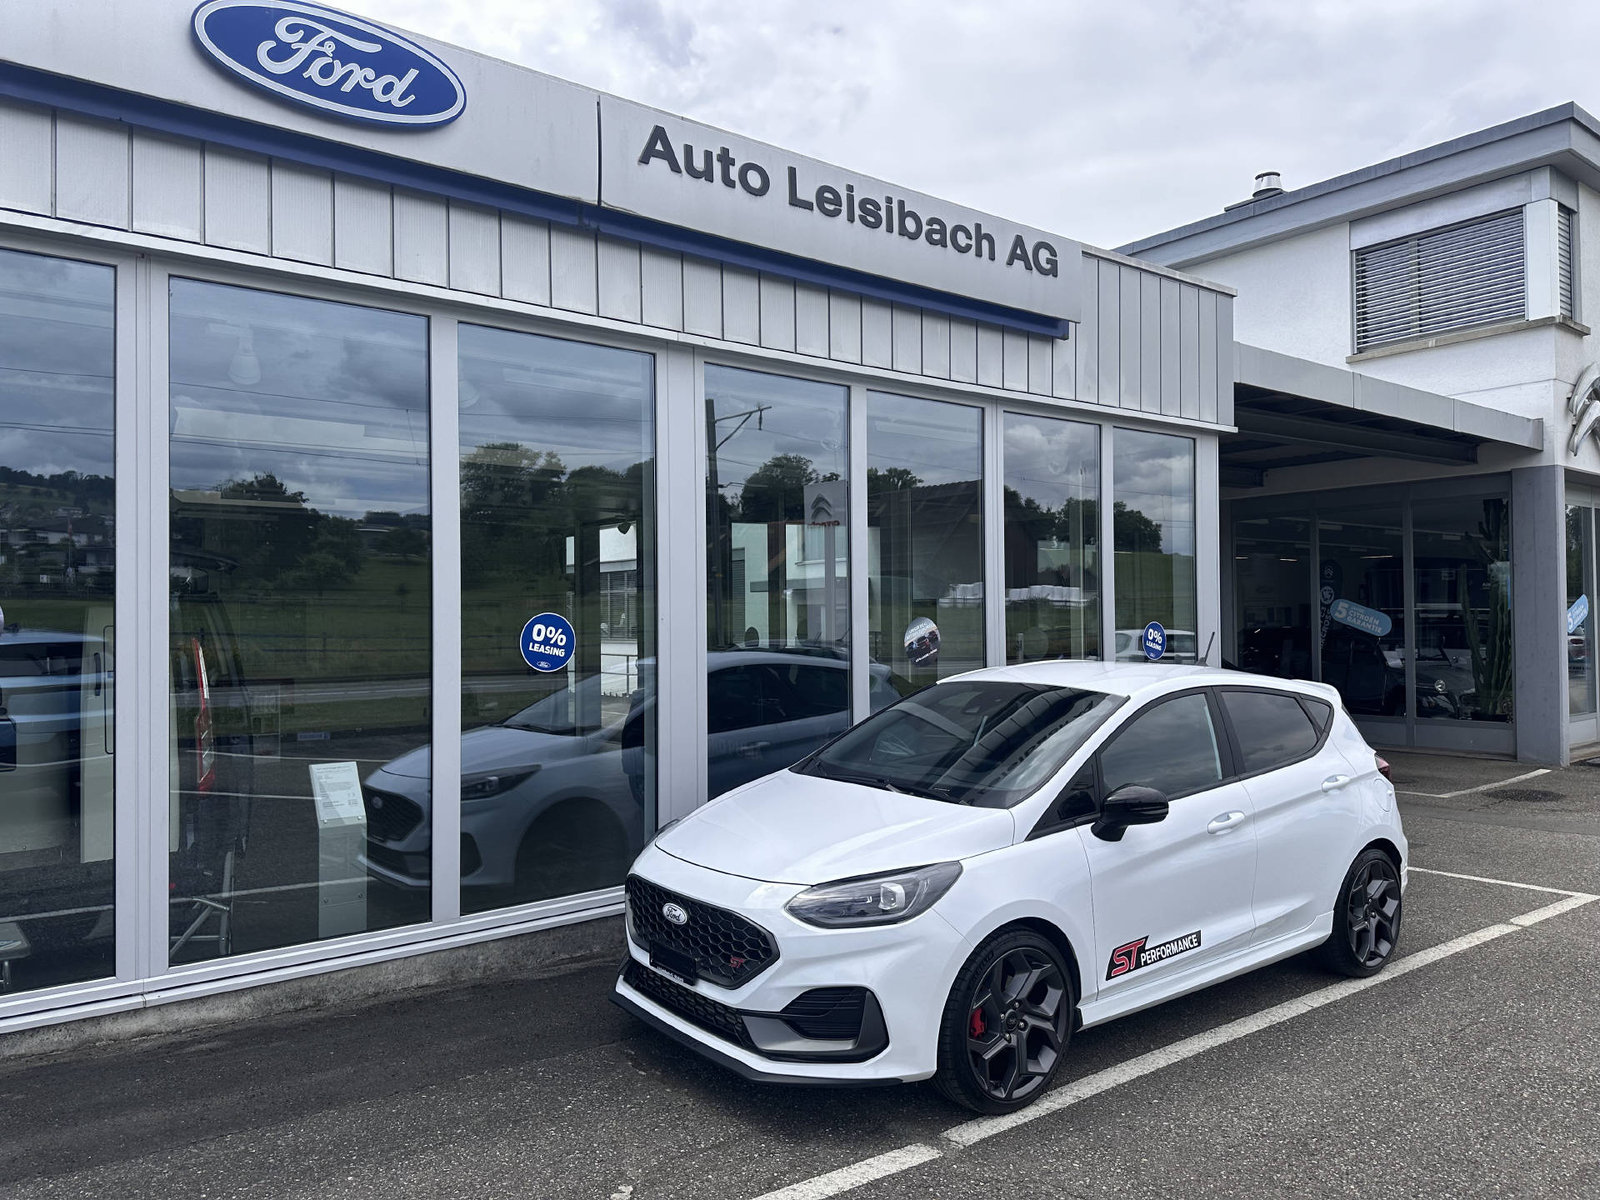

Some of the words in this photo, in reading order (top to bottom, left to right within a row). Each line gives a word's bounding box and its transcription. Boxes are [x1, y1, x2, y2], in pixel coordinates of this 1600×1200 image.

[257, 16, 420, 107] Ford
[638, 125, 770, 196] Auto
[788, 166, 996, 261] Leisibach
[1006, 234, 1058, 277] AG
[1335, 602, 1349, 618] 5
[1347, 616, 1383, 633] GARANTIE
[532, 624, 566, 646] 0%
[1148, 628, 1162, 643] 0%
[529, 642, 565, 657] LEASING
[666, 906, 682, 921] Ford
[729, 956, 745, 968] ST
[1111, 938, 1146, 976] ST
[1140, 934, 1199, 966] PERFORMANCE
